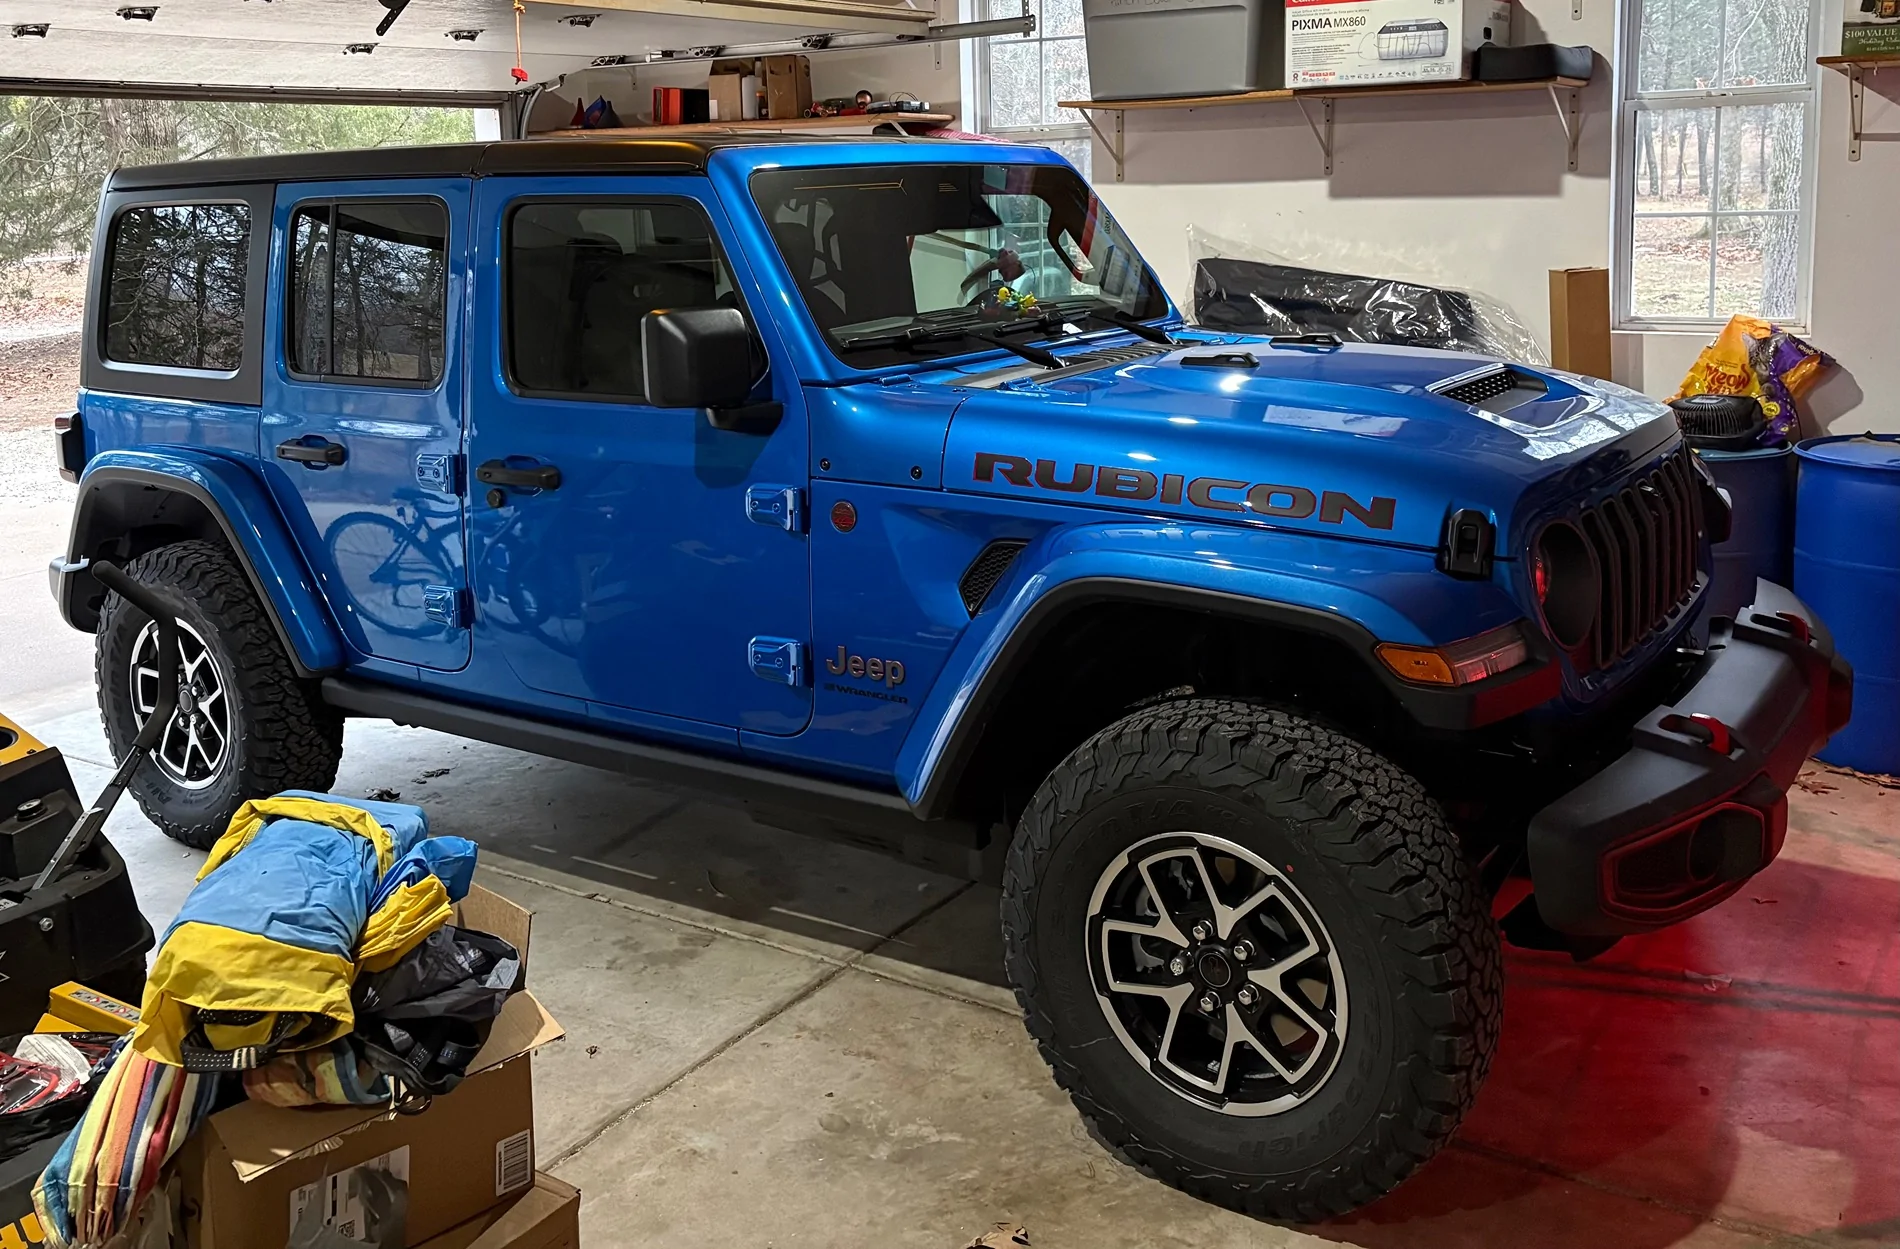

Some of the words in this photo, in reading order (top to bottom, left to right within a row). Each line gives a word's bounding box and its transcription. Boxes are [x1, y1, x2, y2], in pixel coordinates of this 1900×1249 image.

[1292, 17, 1332, 31] PIXMA
[1333, 16, 1366, 28] MX860
[1844, 30, 1865, 39] $100
[1866, 28, 1898, 37] VALUE
[1703, 362, 1751, 389] Meow
[973, 451, 1398, 530] RUBICON
[826, 645, 905, 688] Jeep
[835, 684, 909, 705] WRANGLER
